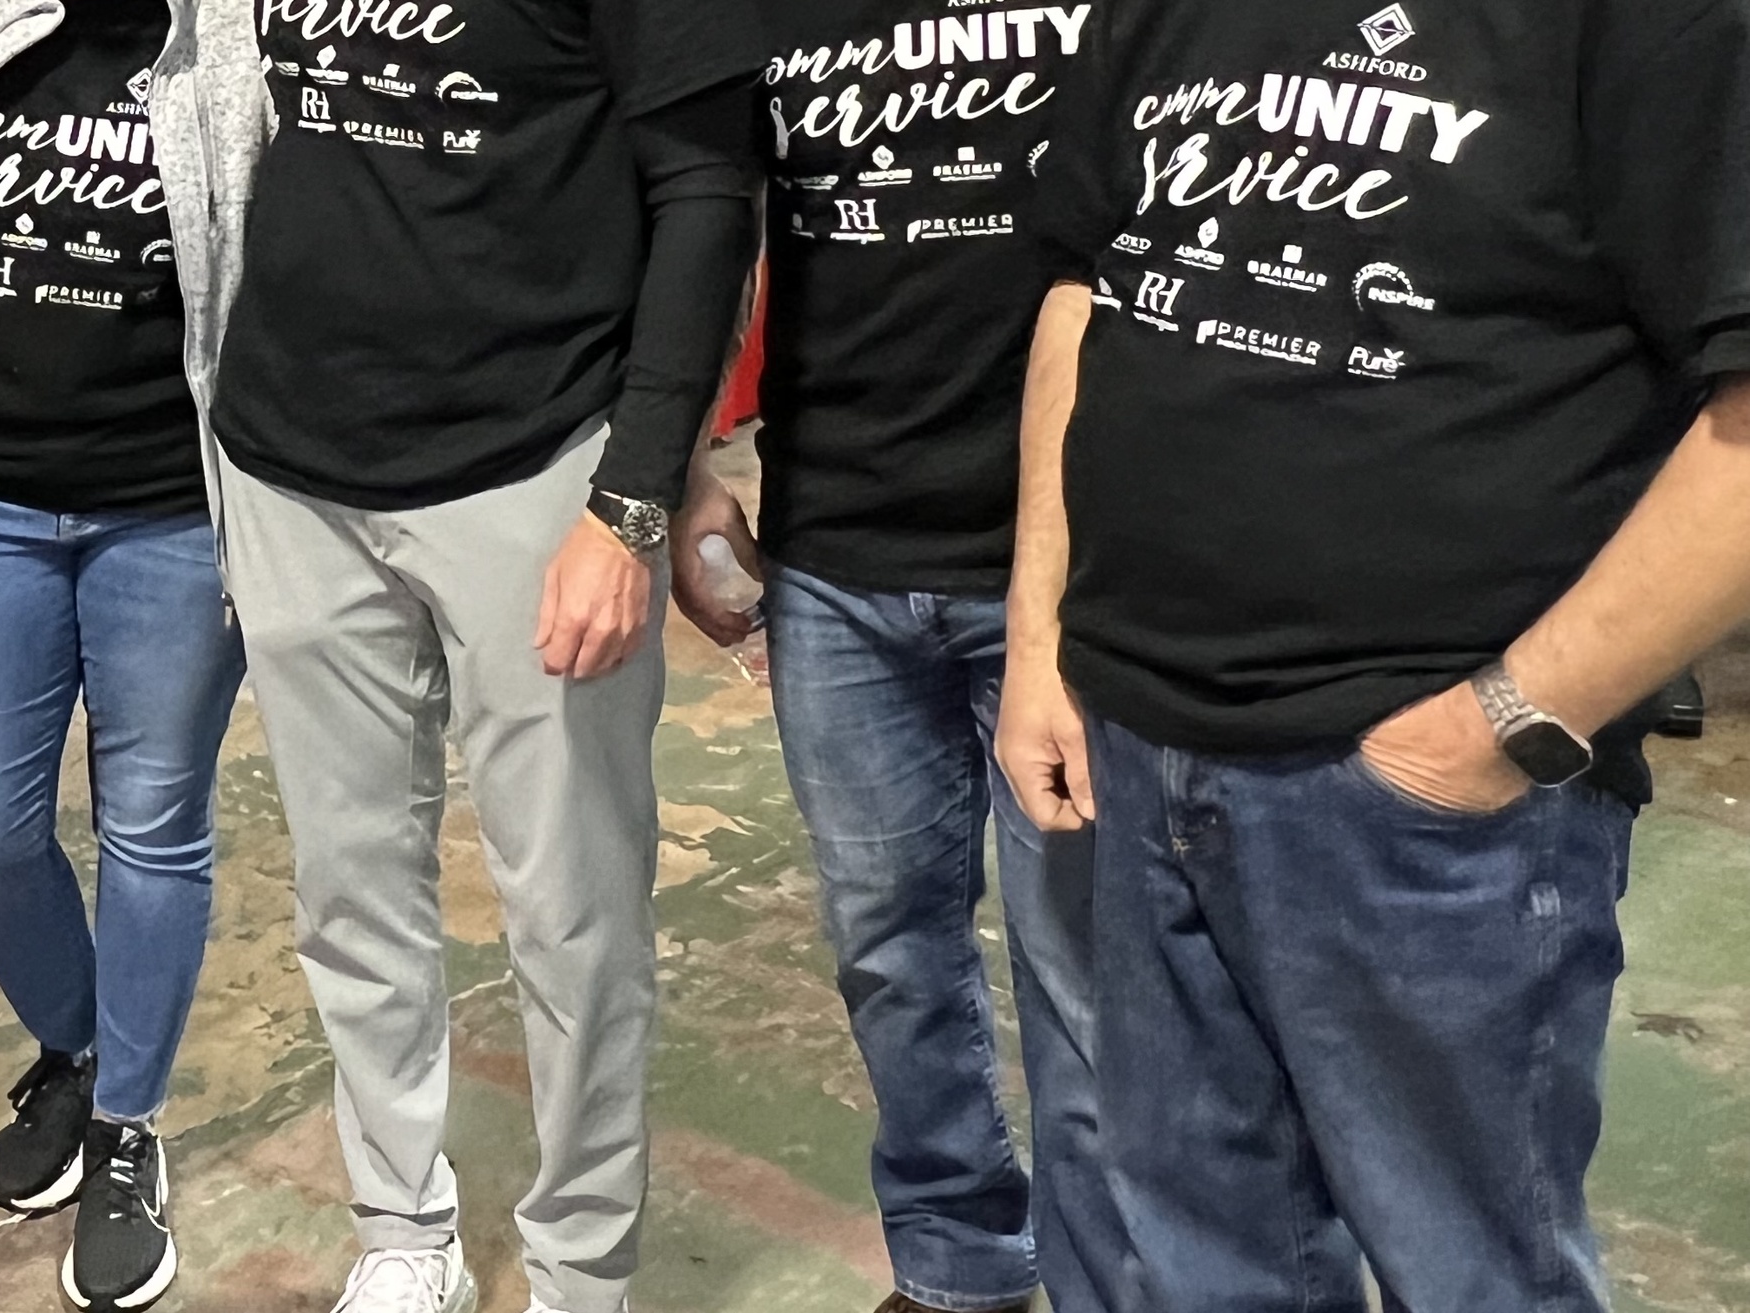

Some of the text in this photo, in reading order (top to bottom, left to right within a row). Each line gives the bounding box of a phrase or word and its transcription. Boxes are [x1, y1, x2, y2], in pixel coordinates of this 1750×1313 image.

[763, 4, 1092, 85] ommUNITY
[1322, 52, 1428, 82] ASHFORD
[834, 198, 881, 230] RH
[1134, 270, 1186, 316] RH
[1217, 321, 1321, 357] PREMIER
